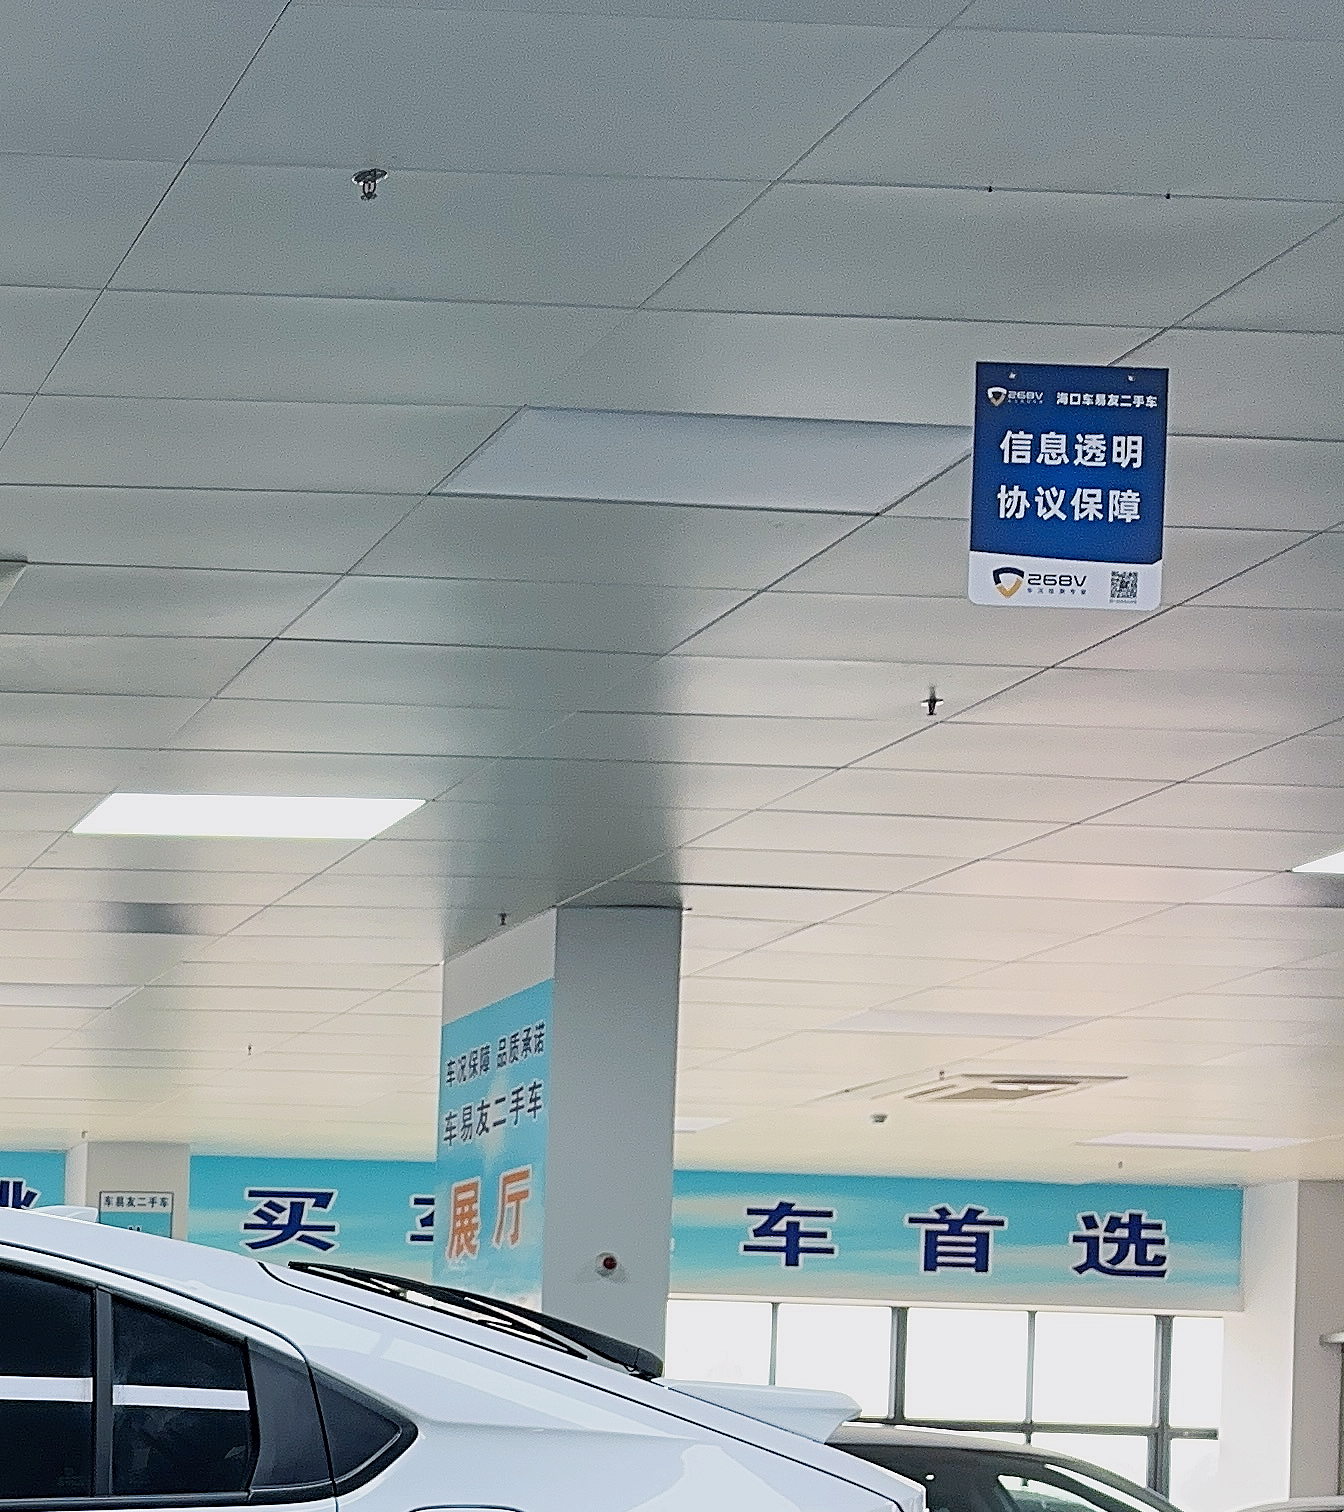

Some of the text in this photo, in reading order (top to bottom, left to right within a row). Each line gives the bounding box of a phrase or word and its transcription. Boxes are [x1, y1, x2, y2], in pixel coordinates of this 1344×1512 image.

[1056, 391, 1159, 409] 海口车易友二手车
[999, 430, 1144, 469] 信息透明
[996, 484, 1141, 523] 协议保障
[1027, 573, 1087, 587] 268V
[442, 1080, 543, 1147] 车易友二手车
[104, 1195, 170, 1209] 车易友二手车
[444, 1164, 532, 1262] 展厅
[742, 1200, 1169, 1278] 车首选
